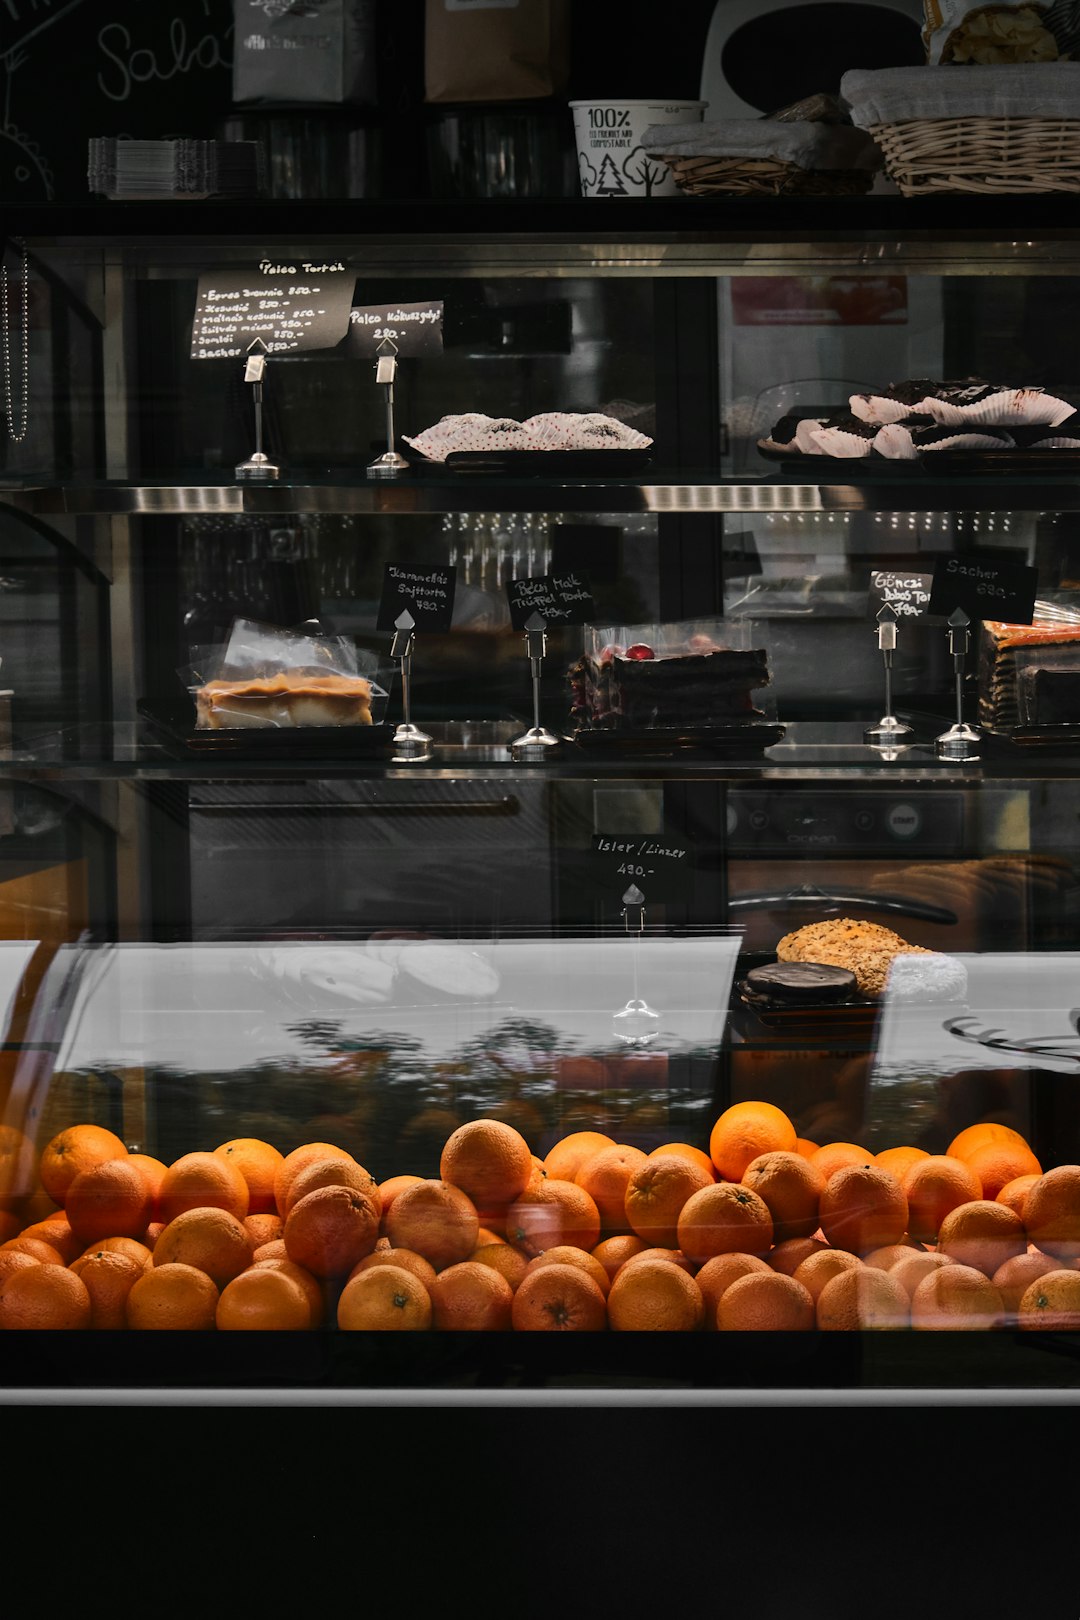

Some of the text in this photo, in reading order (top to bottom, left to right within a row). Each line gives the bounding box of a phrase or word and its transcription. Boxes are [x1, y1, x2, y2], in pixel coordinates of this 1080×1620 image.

[588, 108, 630, 128] 100%
[622, 130, 632, 138] AND
[198, 348, 241, 358] Sacher
[946, 559, 999, 579] Sacher
[398, 583, 447, 599] Sajttorta
[514, 573, 582, 596] Bécsi Mák
[893, 816, 915, 824] START
[597, 838, 635, 854] Isler
[616, 862, 656, 877] 490.-
